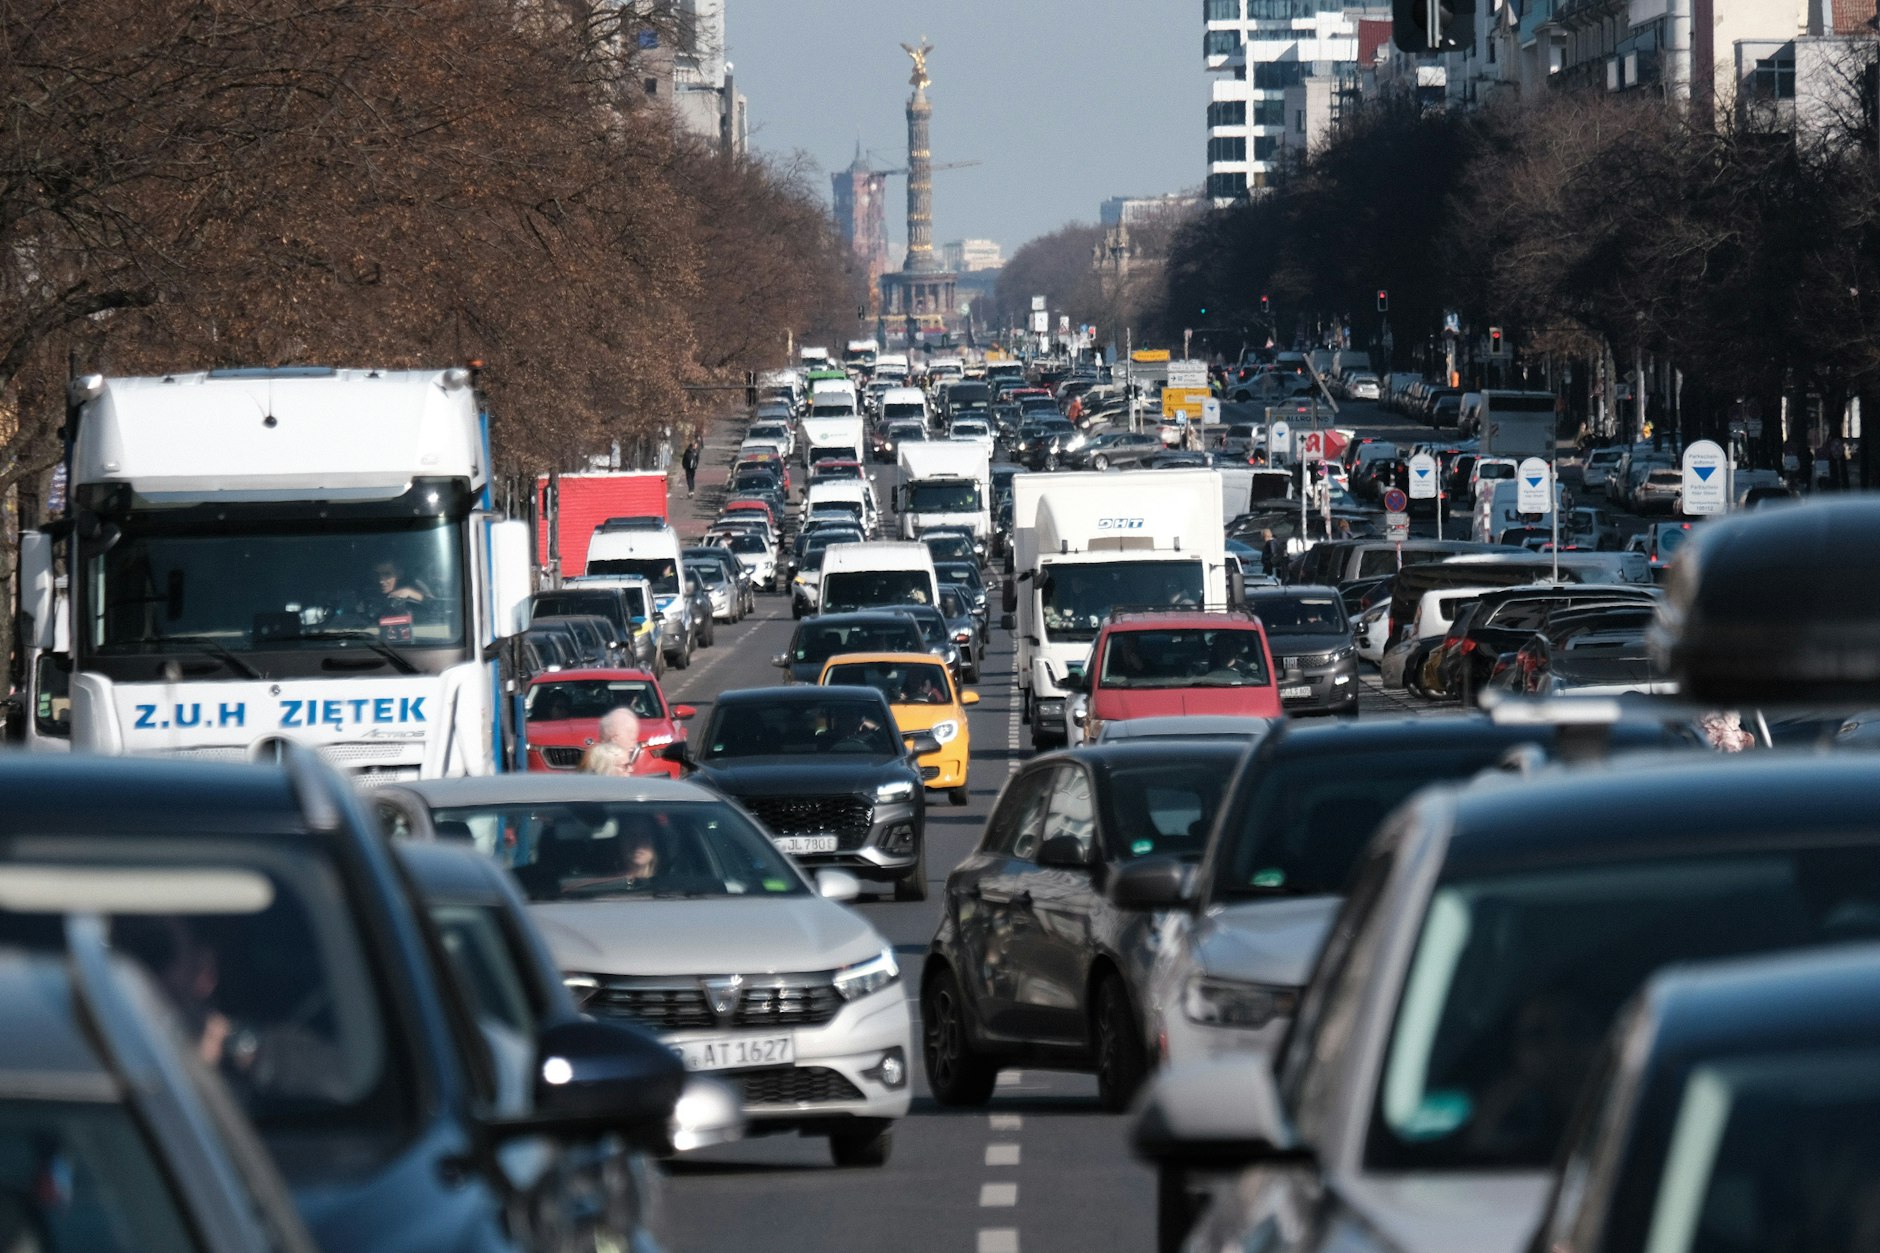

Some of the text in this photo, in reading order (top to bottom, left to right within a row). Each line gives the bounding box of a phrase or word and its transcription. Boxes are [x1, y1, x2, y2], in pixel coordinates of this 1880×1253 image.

[1285, 415, 1330, 423] ALLROND
[1283, 656, 1299, 669] FIAT
[135, 696, 427, 731] Z.U.H ZIĘTEK
[703, 1043, 730, 1066] AT
[736, 1038, 788, 1062] 1627
